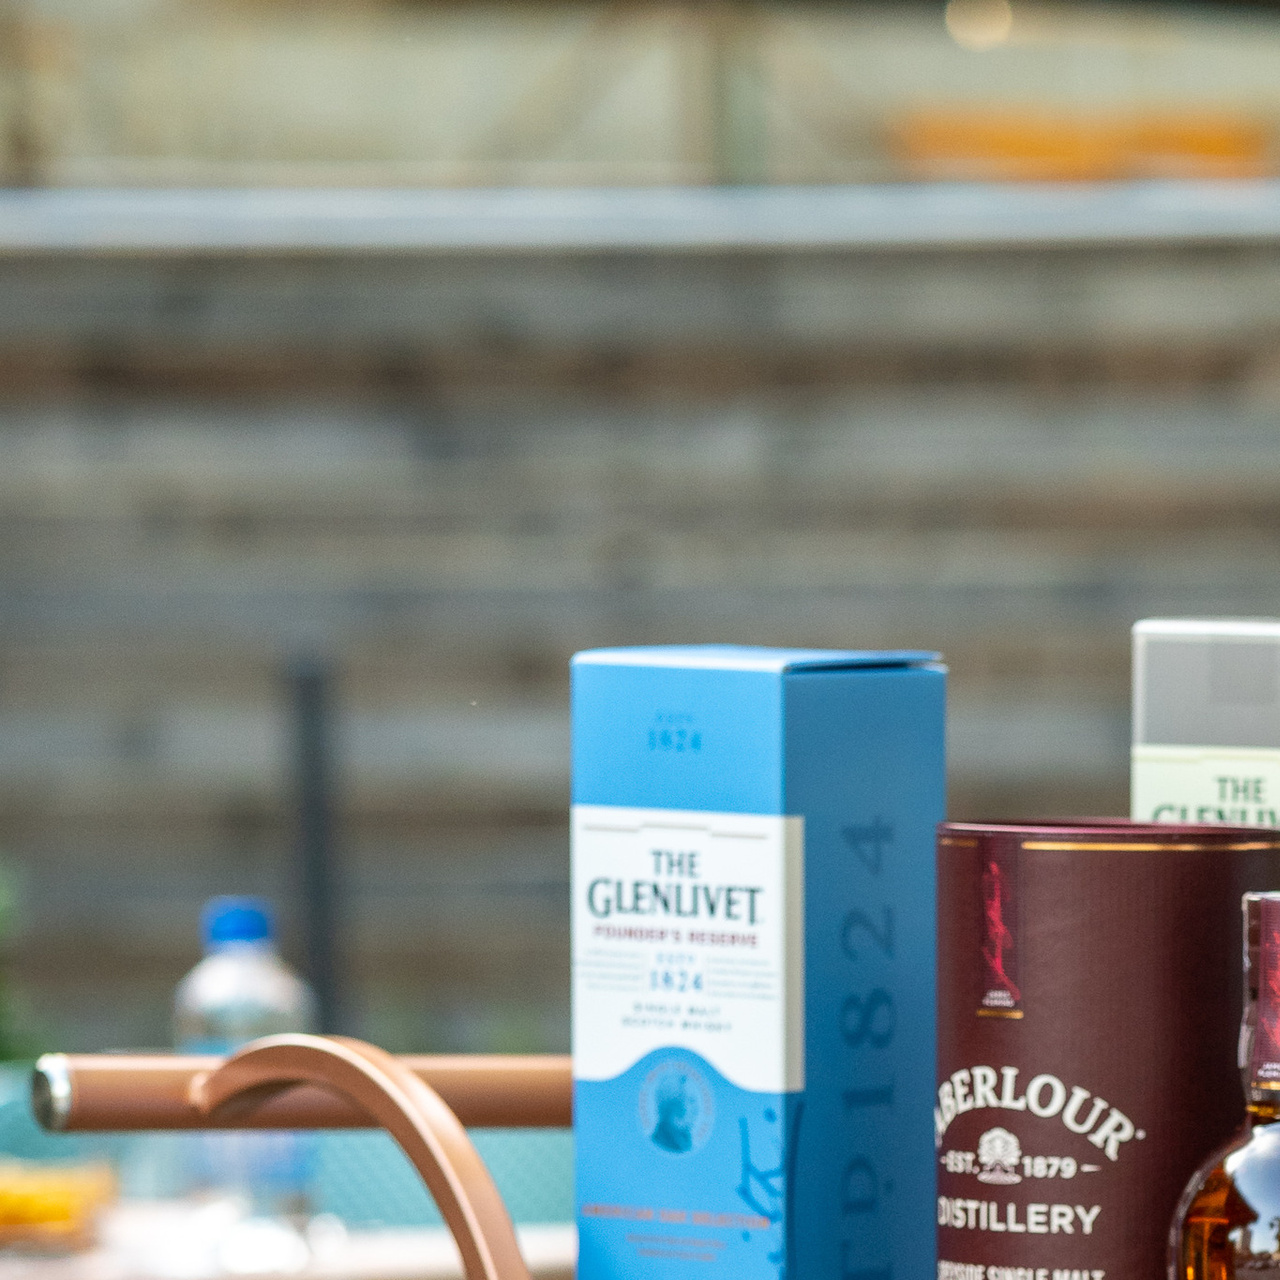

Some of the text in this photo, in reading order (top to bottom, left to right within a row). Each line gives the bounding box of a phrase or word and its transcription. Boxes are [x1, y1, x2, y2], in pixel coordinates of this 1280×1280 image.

[1214, 776, 1267, 804] THE
[652, 849, 700, 879] THE
[587, 878, 764, 925] GLENLIVET
[688, 928, 758, 948] RESERVE
[935, 1065, 1135, 1161] BERLOUR
[1022, 1155, 1078, 1179] 1879
